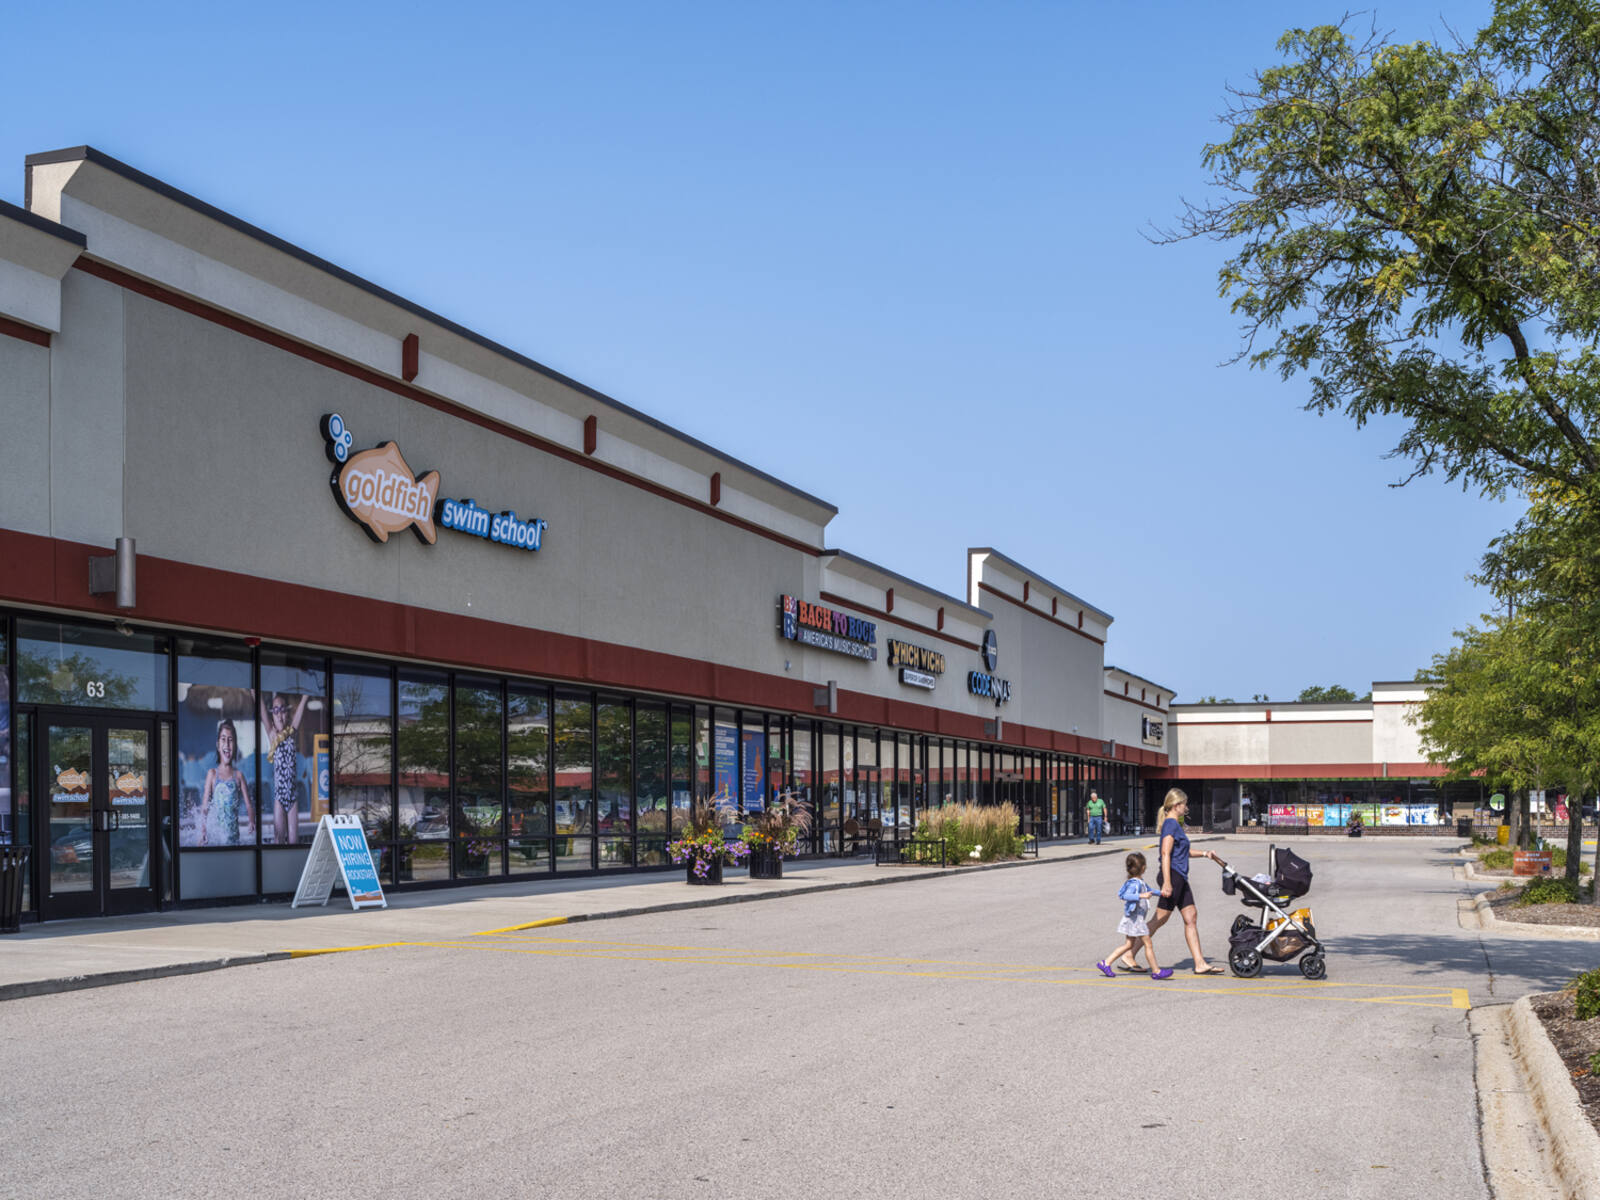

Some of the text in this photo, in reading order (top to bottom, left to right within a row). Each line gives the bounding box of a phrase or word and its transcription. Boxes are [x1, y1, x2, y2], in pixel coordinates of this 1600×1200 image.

[347, 471, 430, 519] goldfish
[443, 502, 541, 547] swim school
[800, 600, 876, 643] BACH TO ROCK
[803, 630, 873, 660] AMERICA'S MUSIC SCHOOL
[87, 681, 105, 697] 63
[971, 671, 992, 697] CODE
[338, 835, 363, 850] NOW
[341, 853, 371, 866] HIRING
